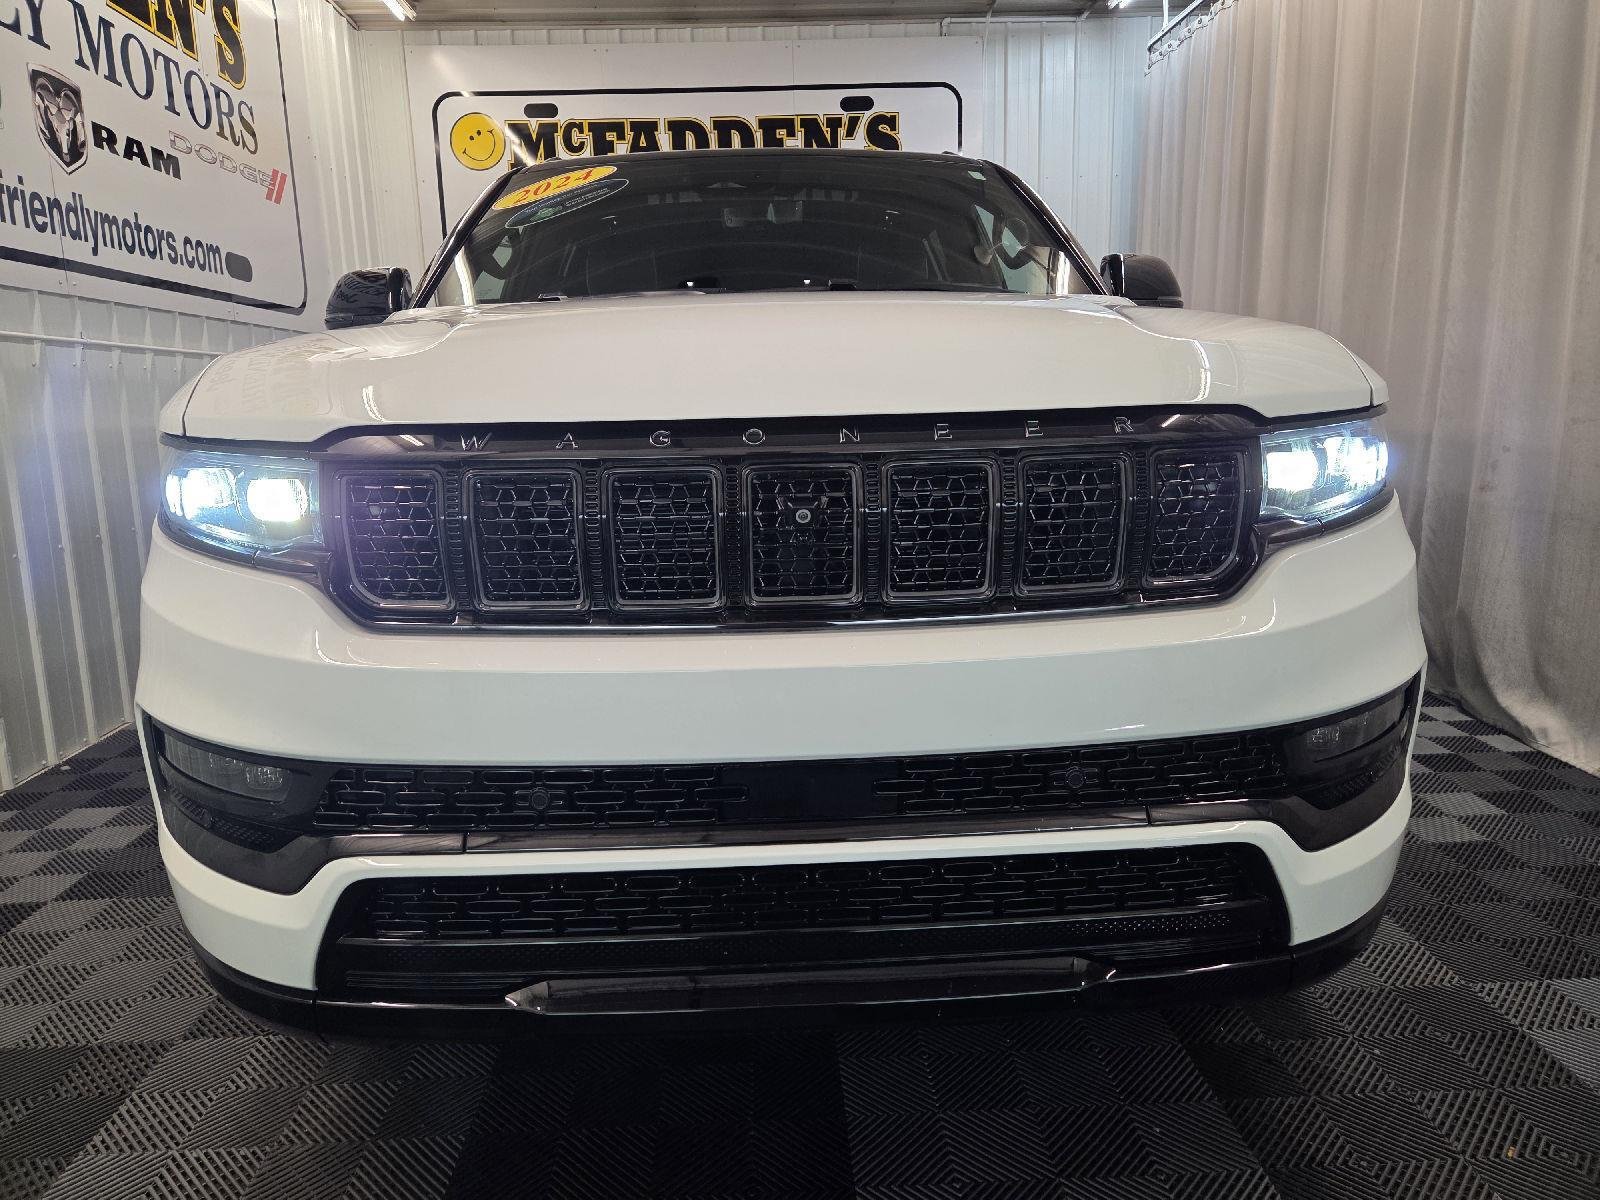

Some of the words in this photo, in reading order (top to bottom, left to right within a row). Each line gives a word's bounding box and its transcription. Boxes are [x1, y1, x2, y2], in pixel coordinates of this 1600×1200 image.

[106, 0, 247, 90] NS
[67, 0, 258, 154] MOTORS
[91, 121, 181, 180] RAM
[169, 130, 274, 190] DODGE
[512, 169, 593, 204] 2024
[0, 168, 224, 276] friendlymotors.com
[460, 416, 1134, 451] WAGONEER
